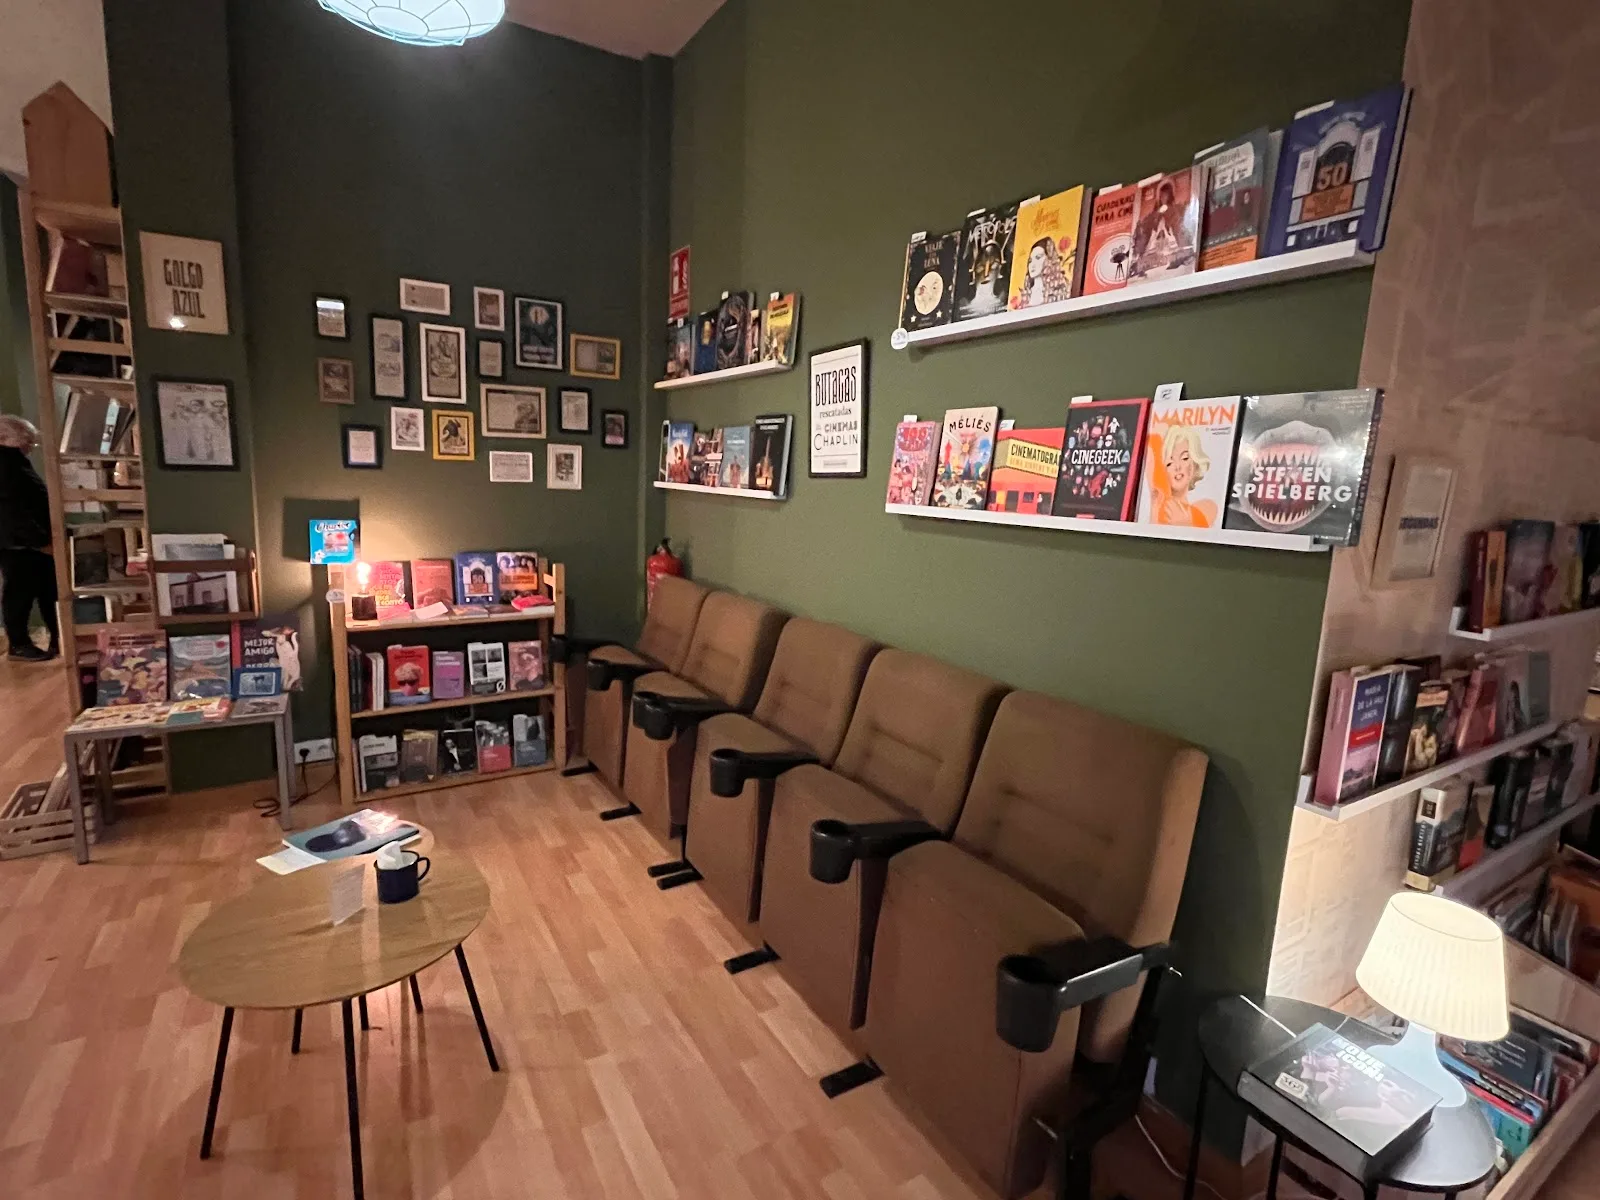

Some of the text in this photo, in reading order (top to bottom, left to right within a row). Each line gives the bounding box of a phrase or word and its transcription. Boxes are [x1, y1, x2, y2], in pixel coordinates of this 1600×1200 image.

[1316, 160, 1350, 191] 50
[163, 259, 204, 289] GALGO
[173, 288, 206, 318] AZUL
[815, 366, 857, 407] BUTACAS
[819, 405, 852, 419] rescatadas
[1151, 403, 1236, 429] MARILYN
[824, 420, 858, 432] CINEMAS
[1071, 449, 1123, 465] CINEGEEK
[1252, 466, 1333, 483] STEVEN
[1231, 483, 1353, 503] SPIELBERG
[244, 638, 274, 649] MEJOR
[244, 646, 275, 656] AMIGO
